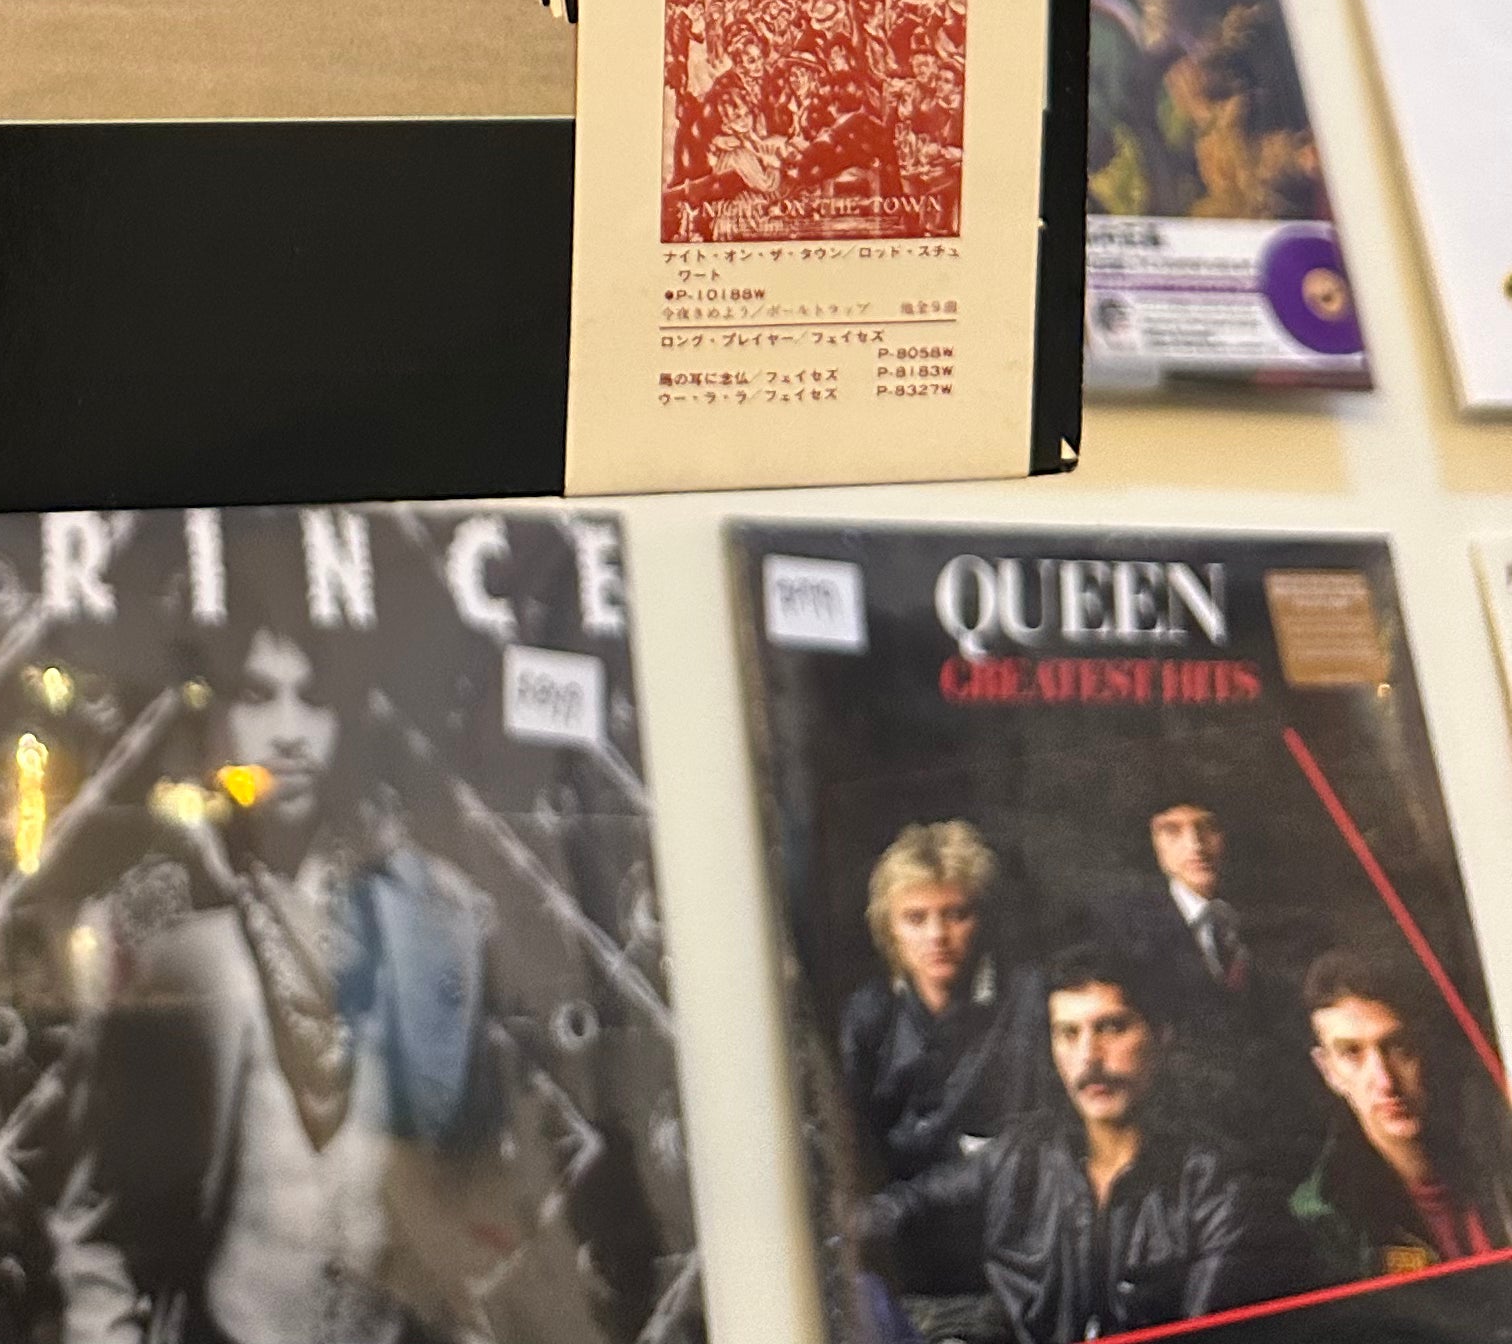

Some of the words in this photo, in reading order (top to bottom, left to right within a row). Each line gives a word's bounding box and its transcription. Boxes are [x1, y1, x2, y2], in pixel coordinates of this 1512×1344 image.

[935, 554, 1228, 664] QUEEN
[940, 658, 1152, 704] GREATEST
[1162, 660, 1261, 704] HITS
